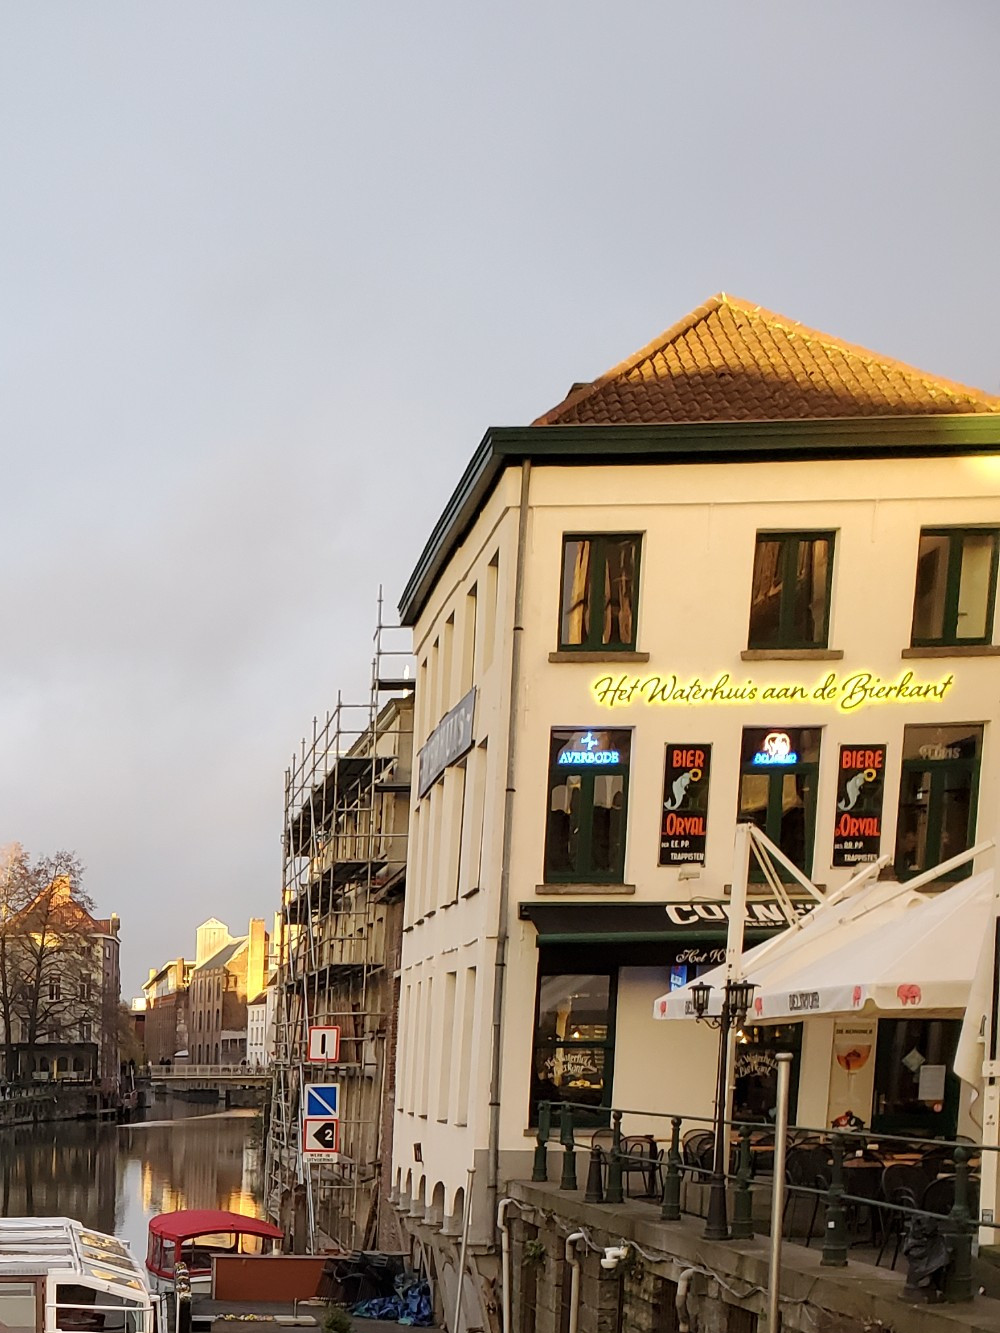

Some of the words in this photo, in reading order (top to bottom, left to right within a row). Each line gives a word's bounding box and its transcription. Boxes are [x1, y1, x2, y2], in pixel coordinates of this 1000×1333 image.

[594, 675, 640, 706] Het
[641, 674, 758, 702] Waterhuis
[763, 686, 808, 700] aan
[813, 674, 837, 700] de
[841, 672, 953, 709] Bierkant
[559, 752, 619, 763] AVERBODE
[672, 750, 704, 767] BIER
[842, 750, 882, 768] BIERE
[666, 813, 706, 835] ORVAL
[324, 1129, 333, 1140] 2
